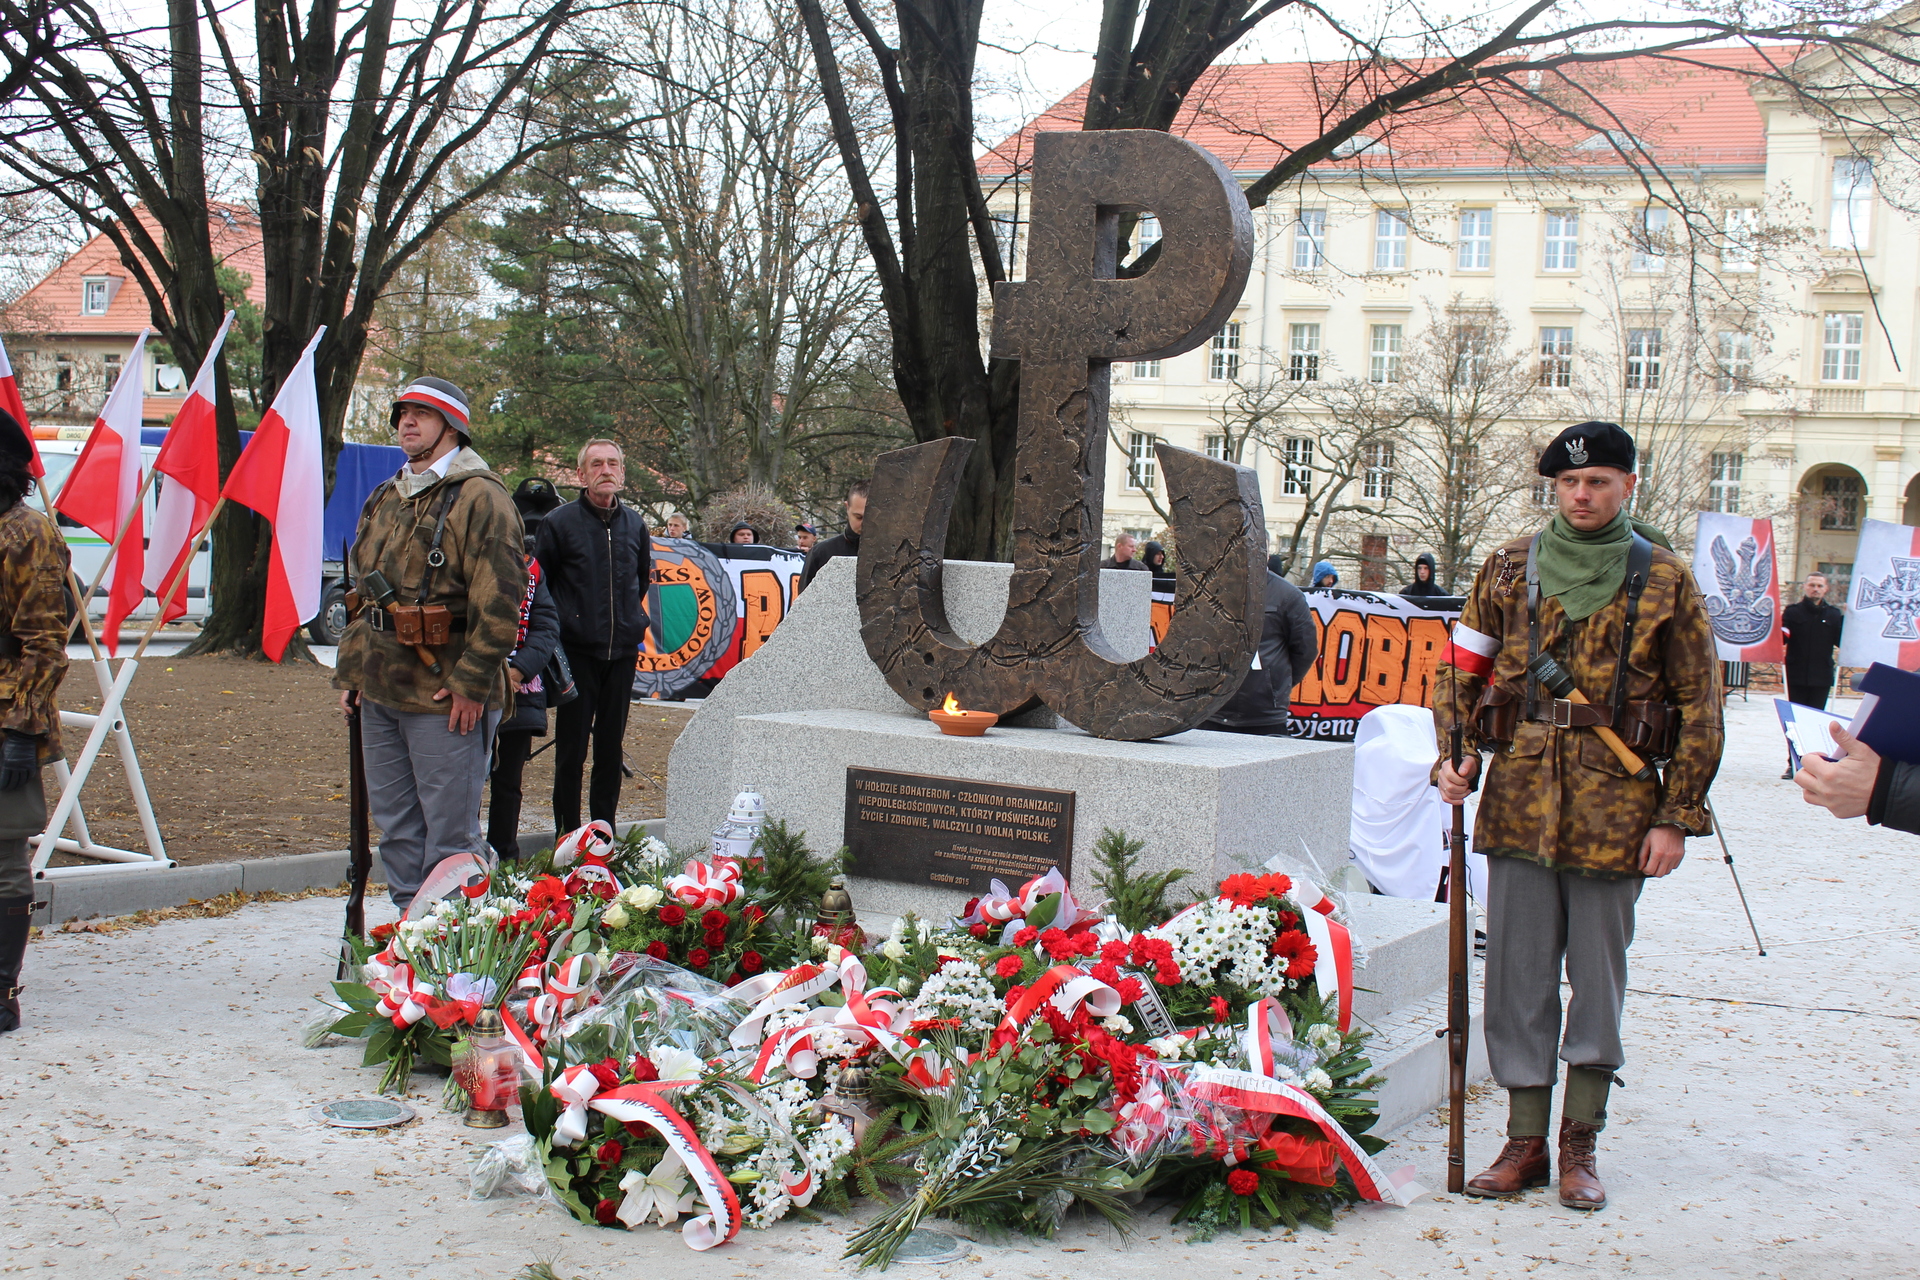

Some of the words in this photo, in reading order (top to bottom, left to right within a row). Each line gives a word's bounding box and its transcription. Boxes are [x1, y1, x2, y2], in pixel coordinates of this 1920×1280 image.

[650, 568, 690, 583] KS
[669, 587, 714, 668] GŁOGÓW
[856, 780, 864, 790] W
[865, 781, 897, 794] HOŁDZIE
[900, 785, 950, 800] BOHATEROM
[958, 791, 1003, 806] CZŁONKOM
[1006, 797, 1062, 813] ORGANIZACJI
[859, 795, 958, 817] NIEPODLEGŁOŚCIOWYCH,
[961, 806, 993, 820] KTÓRZY
[996, 811, 1057, 829] POŚWIĘCAJĄC
[861, 808, 883, 822] ŻYCIE
[886, 814, 888, 823] I
[891, 814, 930, 830] ZDROWIE,
[933, 819, 973, 833] WALCZYLI
[976, 824, 981, 834] O
[985, 825, 1014, 840] WOLNĄ
[1016, 829, 1051, 844] POLSKĘ.
[930, 871, 954, 883] GŁOGÓW
[955, 876, 969, 885] 2015
